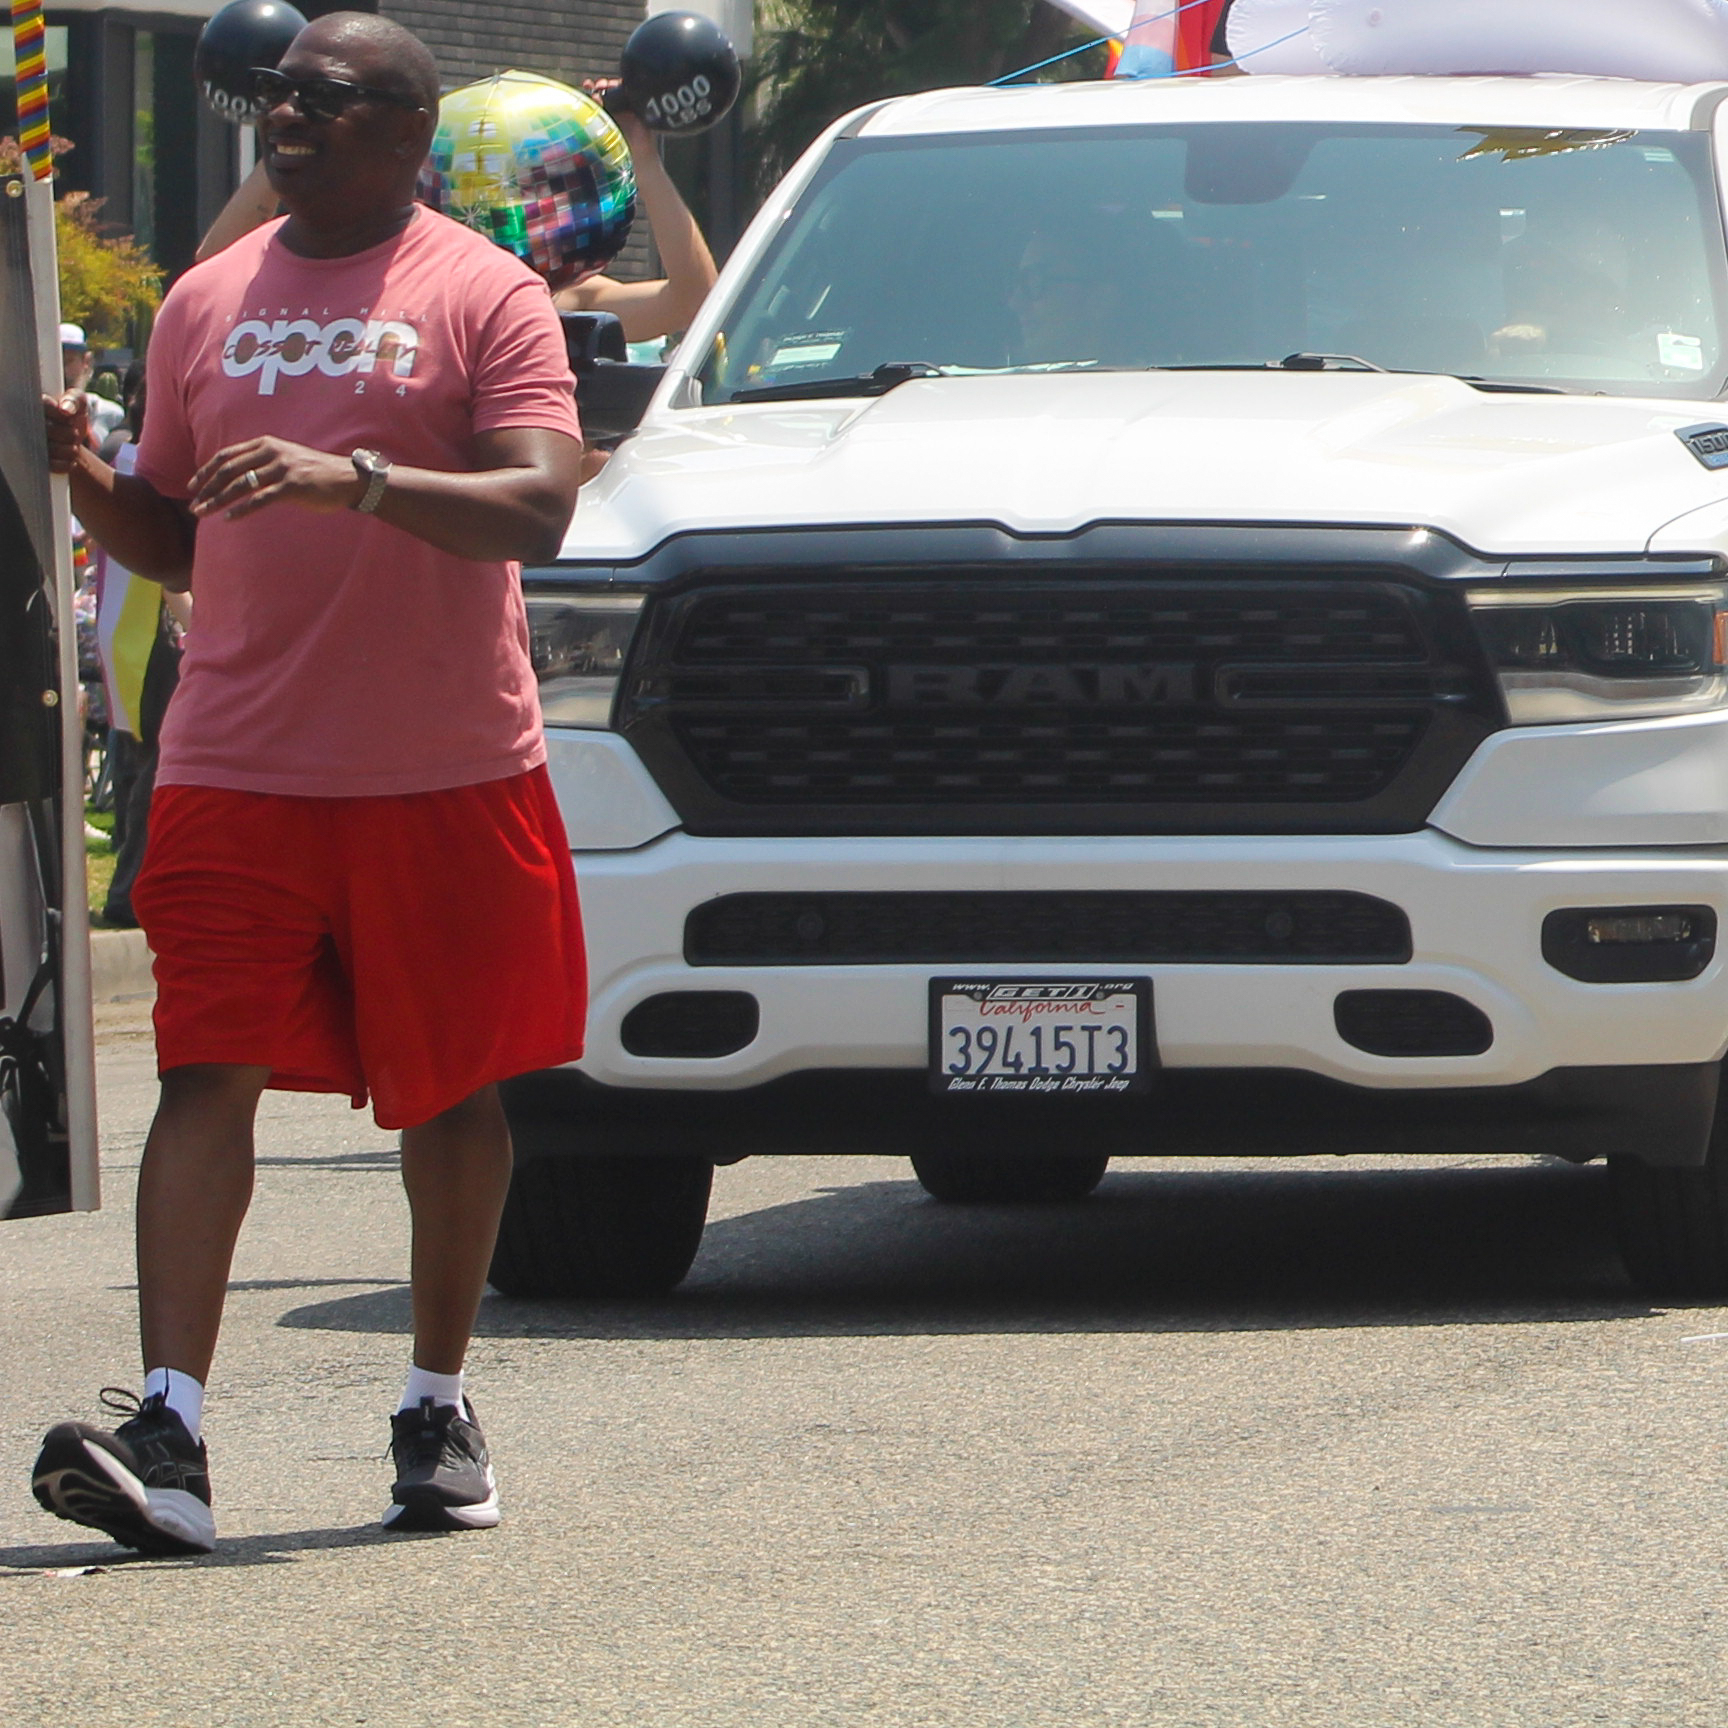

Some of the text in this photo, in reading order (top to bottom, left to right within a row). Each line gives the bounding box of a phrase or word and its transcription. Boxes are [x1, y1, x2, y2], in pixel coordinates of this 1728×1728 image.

[646, 74, 711, 118] 1000
[885, 663, 1197, 707] RAM
[979, 1000, 1105, 1023] California
[949, 1025, 1129, 1074] 39415T3
[990, 1076, 1027, 1090] Thomas
[1029, 1076, 1059, 1092] Dodge
[1061, 1076, 1103, 1092] Chrysler
[1105, 1076, 1130, 1092] Jeep
